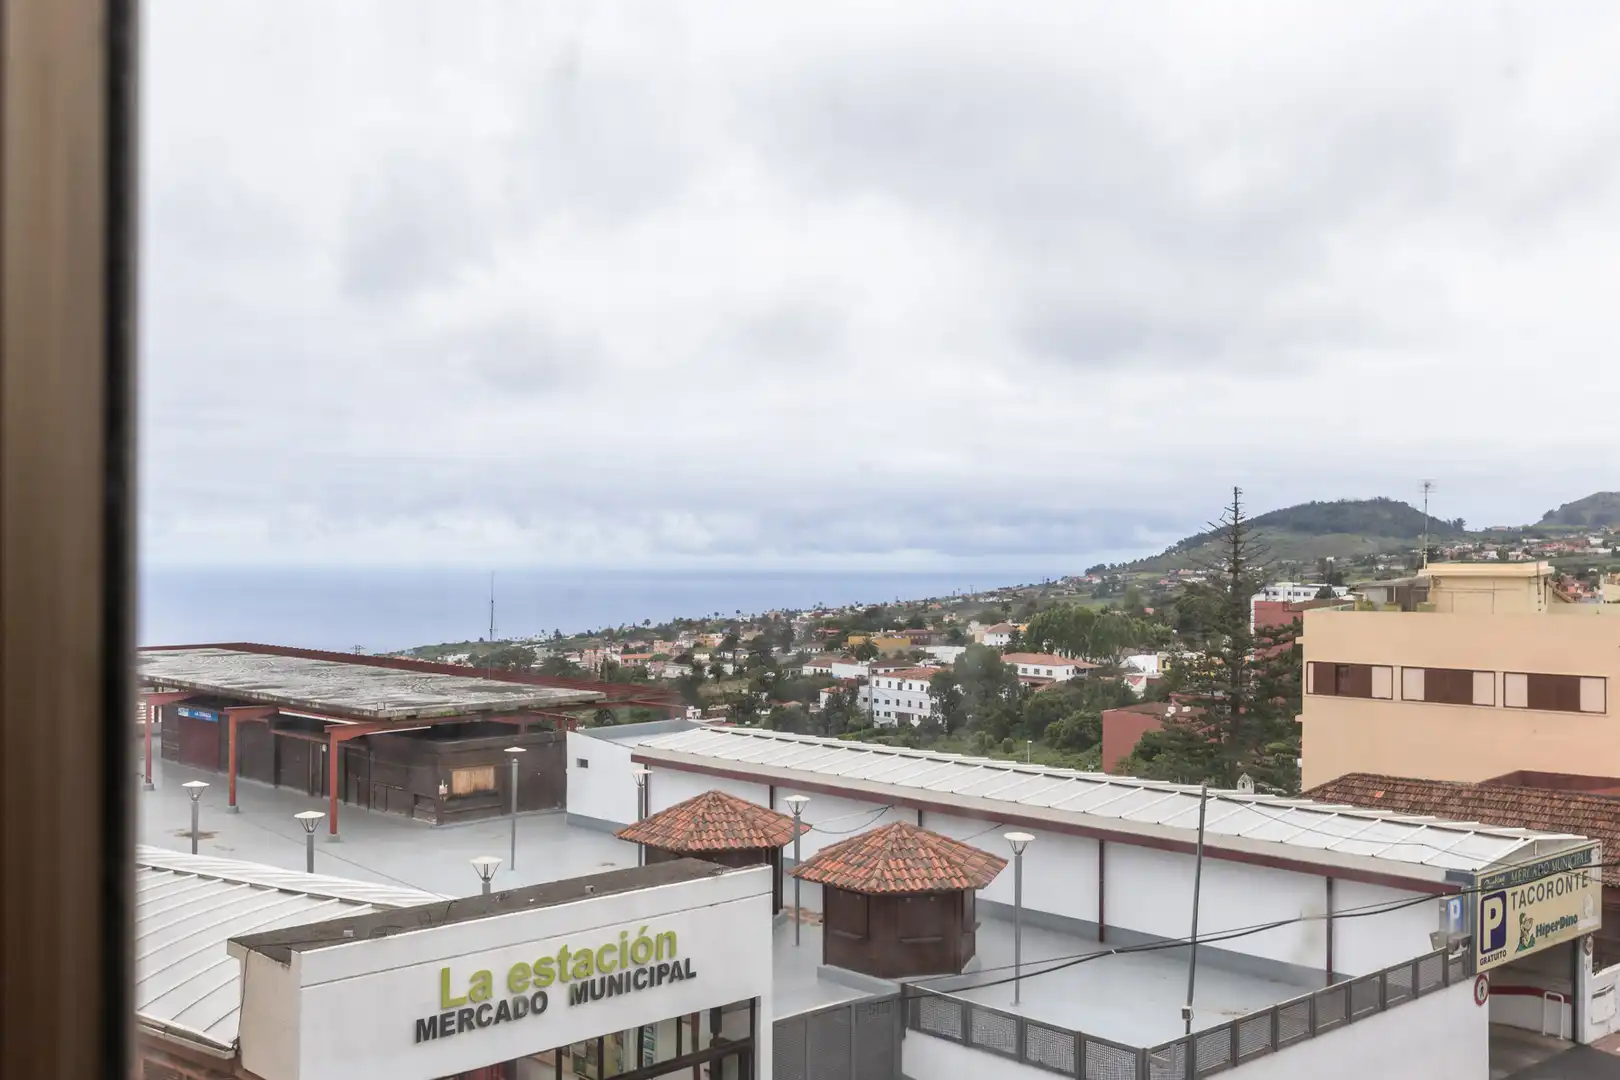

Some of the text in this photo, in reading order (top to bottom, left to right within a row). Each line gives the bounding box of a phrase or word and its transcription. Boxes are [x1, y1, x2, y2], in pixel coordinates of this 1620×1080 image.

[1511, 863, 1551, 881] MERCADO
[1551, 851, 1589, 872] MUNICIPAL
[1511, 871, 1588, 911] TACORONTE
[1449, 899, 1460, 920] P
[1483, 897, 1503, 951] P
[1535, 914, 1578, 938] HiperDino
[440, 926, 677, 1008] La estación
[1479, 949, 1507, 966] GRATUITO
[415, 958, 697, 1044] MERCADO MUNICIPAL
